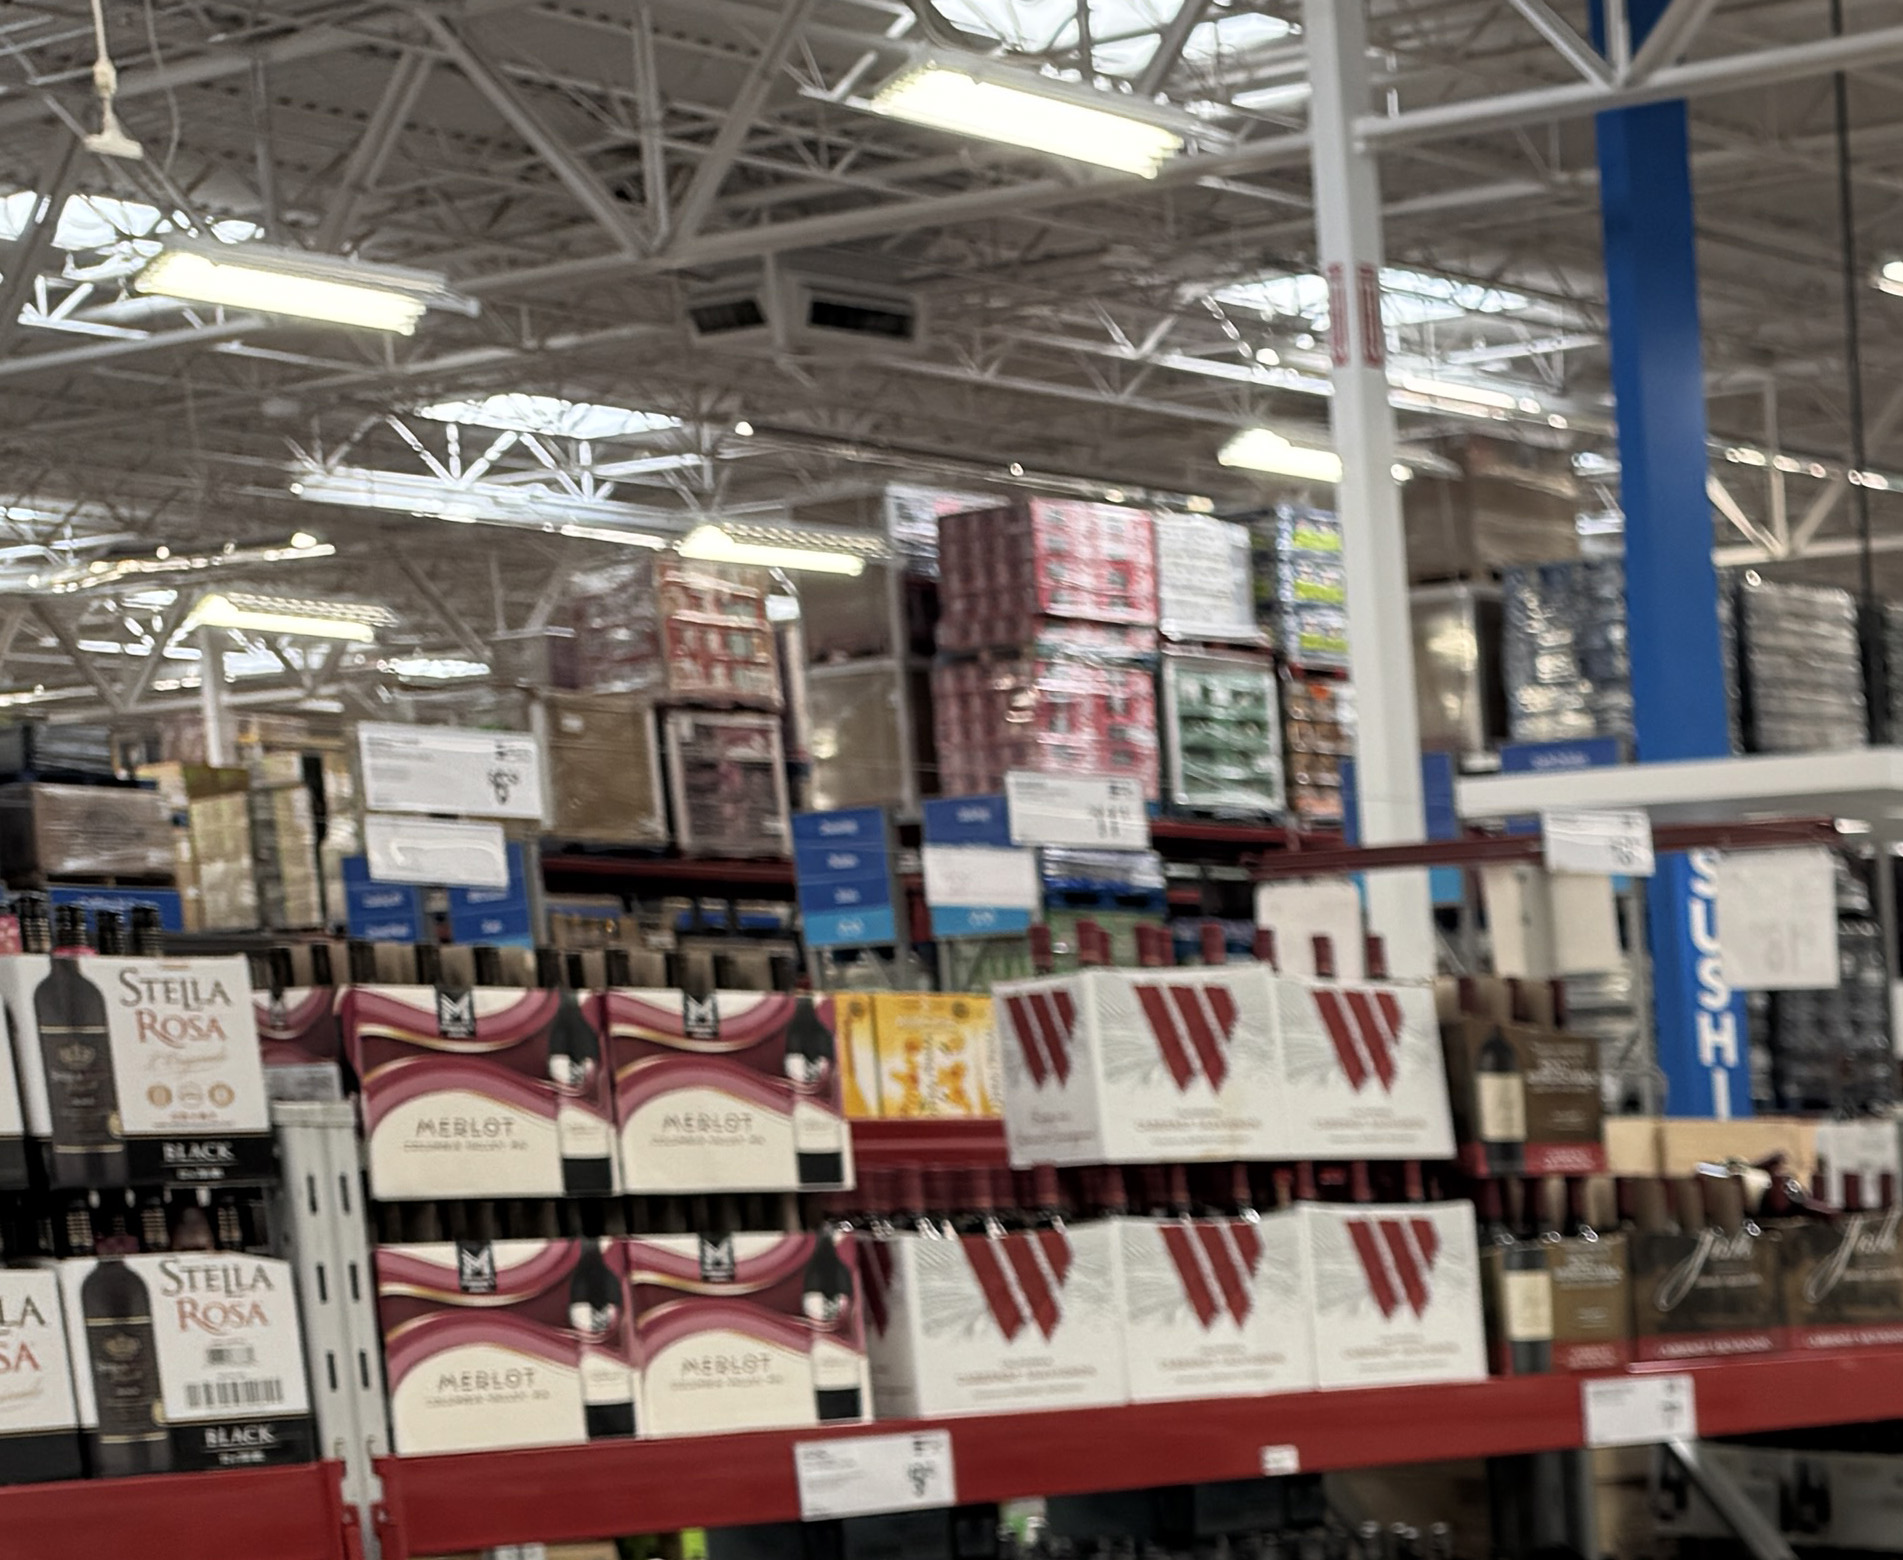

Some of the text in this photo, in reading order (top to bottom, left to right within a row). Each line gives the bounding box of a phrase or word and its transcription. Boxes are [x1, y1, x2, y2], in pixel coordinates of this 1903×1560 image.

[119, 966, 232, 1011] STELLA
[1688, 846, 1738, 1120] SUSHI
[135, 1009, 228, 1048] ROSA
[416, 1116, 515, 1138] MERLOT
[662, 1112, 753, 1133] MERLOT
[162, 1141, 237, 1163] BLACK
[159, 1257, 274, 1298] STELLA
[176, 1296, 270, 1335] ROSA
[681, 1352, 773, 1377] MERLOT
[438, 1367, 536, 1392] MERLOT
[204, 1425, 277, 1448] BLACK
